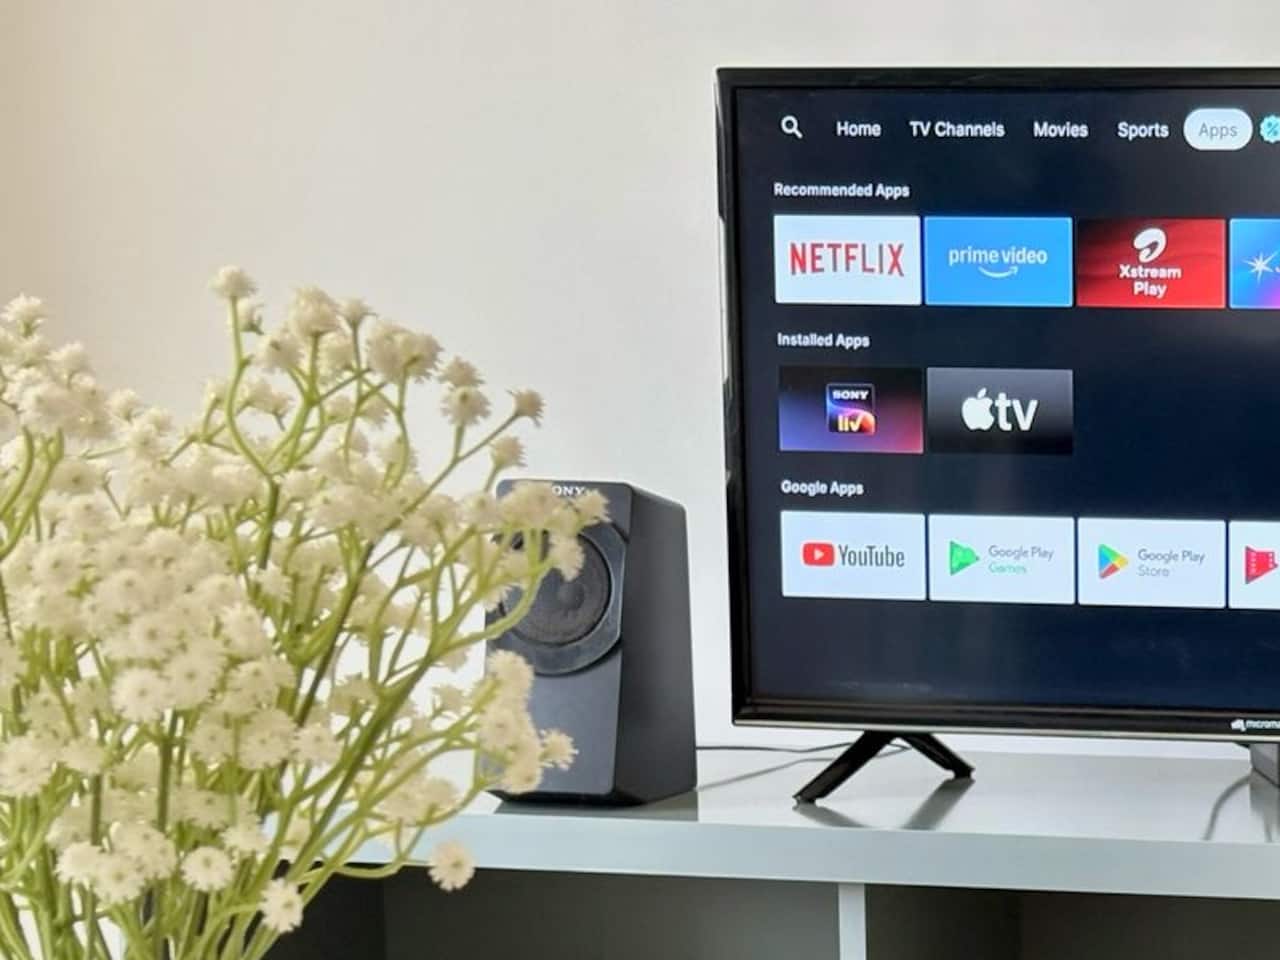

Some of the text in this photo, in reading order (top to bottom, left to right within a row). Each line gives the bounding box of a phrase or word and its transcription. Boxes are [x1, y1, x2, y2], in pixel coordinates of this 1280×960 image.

[836, 121, 882, 138] Home
[909, 121, 1005, 138] TV Channels
[1033, 121, 1089, 138] Movies
[1117, 121, 1170, 141] Sports
[1199, 122, 1238, 141] Apps
[773, 182, 910, 200] Recommended Apps
[789, 242, 905, 277] NETFLIX
[949, 246, 1048, 266] prime video
[1118, 264, 1182, 280] Xstream
[1133, 281, 1168, 299] Play
[777, 332, 870, 350] Installed Apps
[832, 389, 869, 400] SONY
[995, 392, 1038, 432] tv
[780, 479, 864, 498] Google Apps
[838, 544, 905, 567] YouTube
[988, 545, 1055, 563] Google Play
[1138, 548, 1205, 566] Google Play
[988, 561, 1027, 575] Games
[1138, 565, 1170, 578] Store
